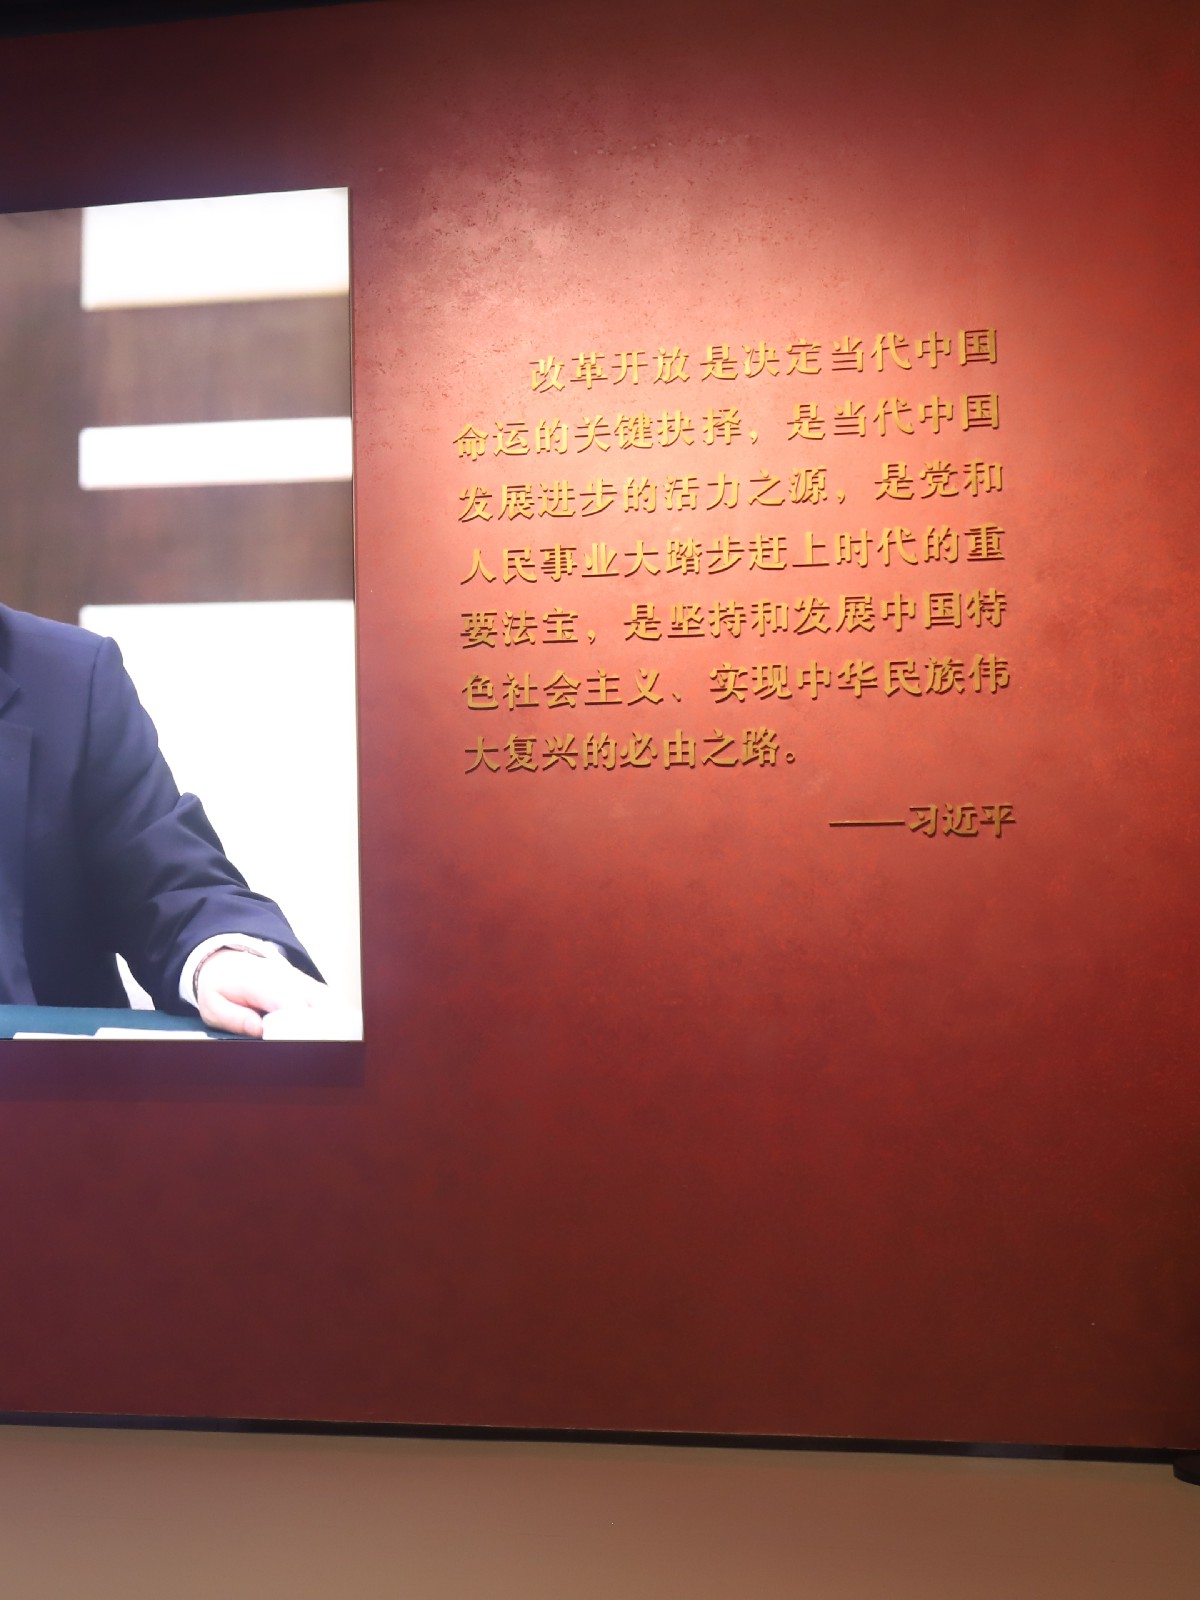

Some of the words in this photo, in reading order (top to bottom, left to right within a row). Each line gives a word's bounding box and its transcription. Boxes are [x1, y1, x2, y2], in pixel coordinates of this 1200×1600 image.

[529, 327, 998, 393] 改革开放是决定当代中国
[453, 391, 1000, 462] 命运的关键抉择，是当代中国
[457, 457, 1004, 523] 发展进步的活力之源，是党和
[460, 522, 1006, 585] 人民事业大踏步赶上时代的重
[460, 587, 1007, 648] 要法宝，是坚持和发展中国特
[461, 653, 1010, 710] 色社会主义、实现中华民族伟
[464, 726, 796, 773] 大复兴的必由之路。
